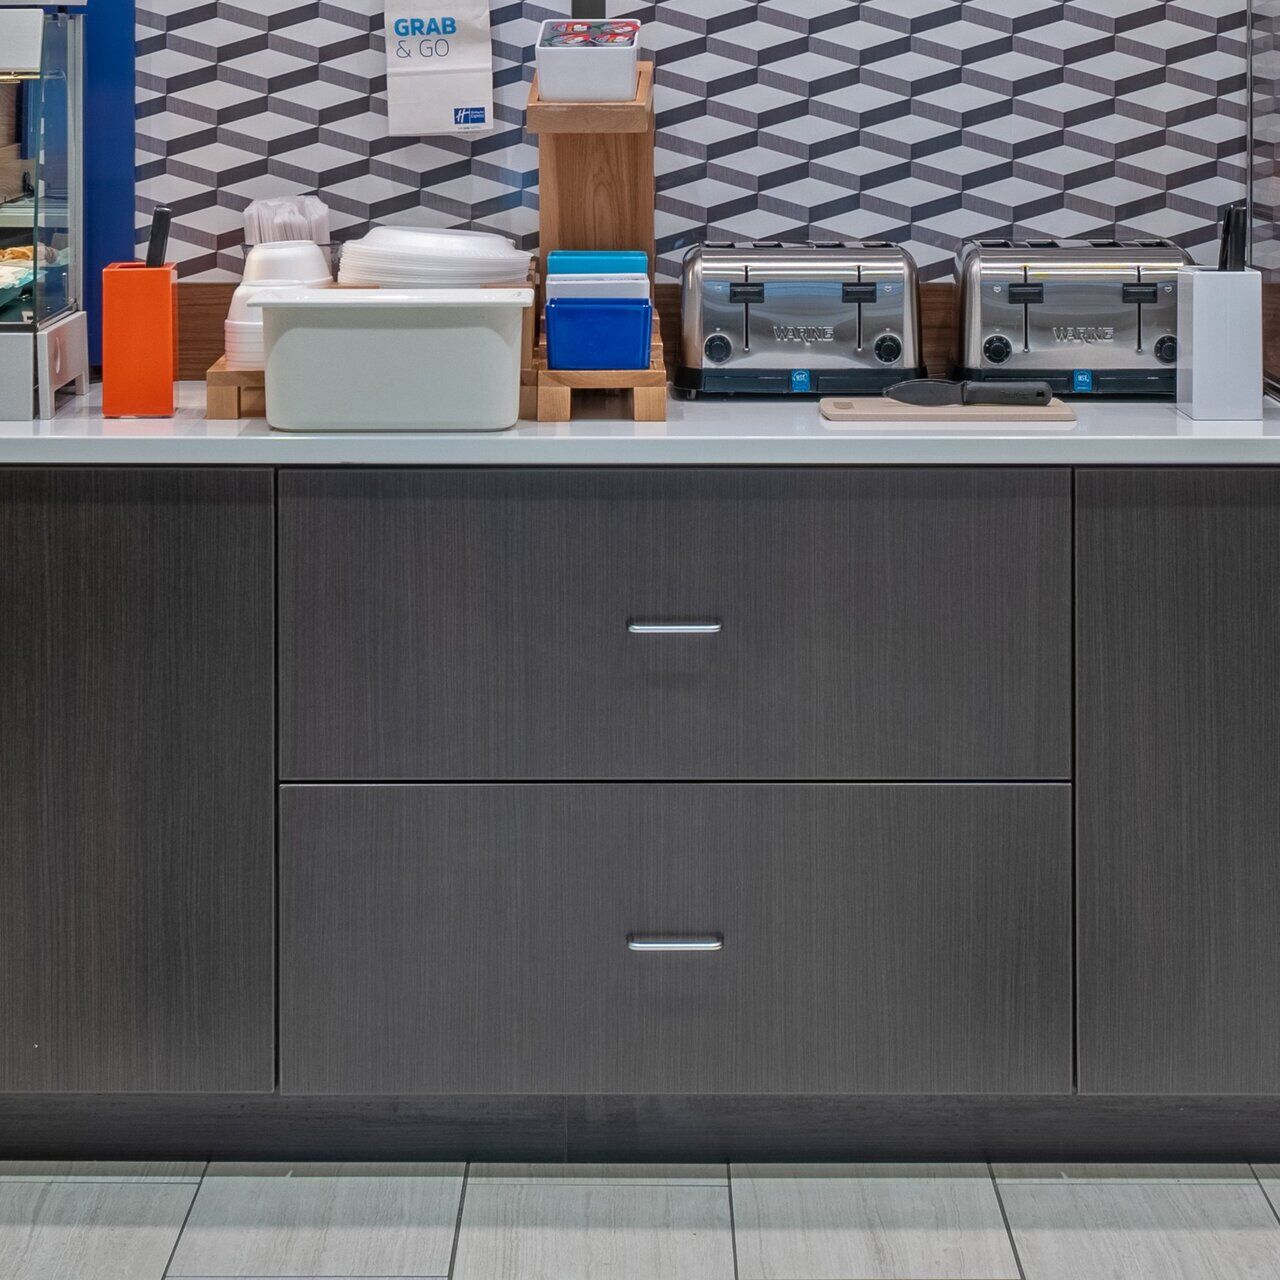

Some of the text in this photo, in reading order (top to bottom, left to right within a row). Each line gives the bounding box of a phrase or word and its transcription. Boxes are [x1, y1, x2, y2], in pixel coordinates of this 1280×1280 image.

[394, 16, 457, 37] GRAB
[396, 38, 450, 58] & GO
[773, 326, 834, 346] WARING
[1052, 326, 1114, 345] WARING
